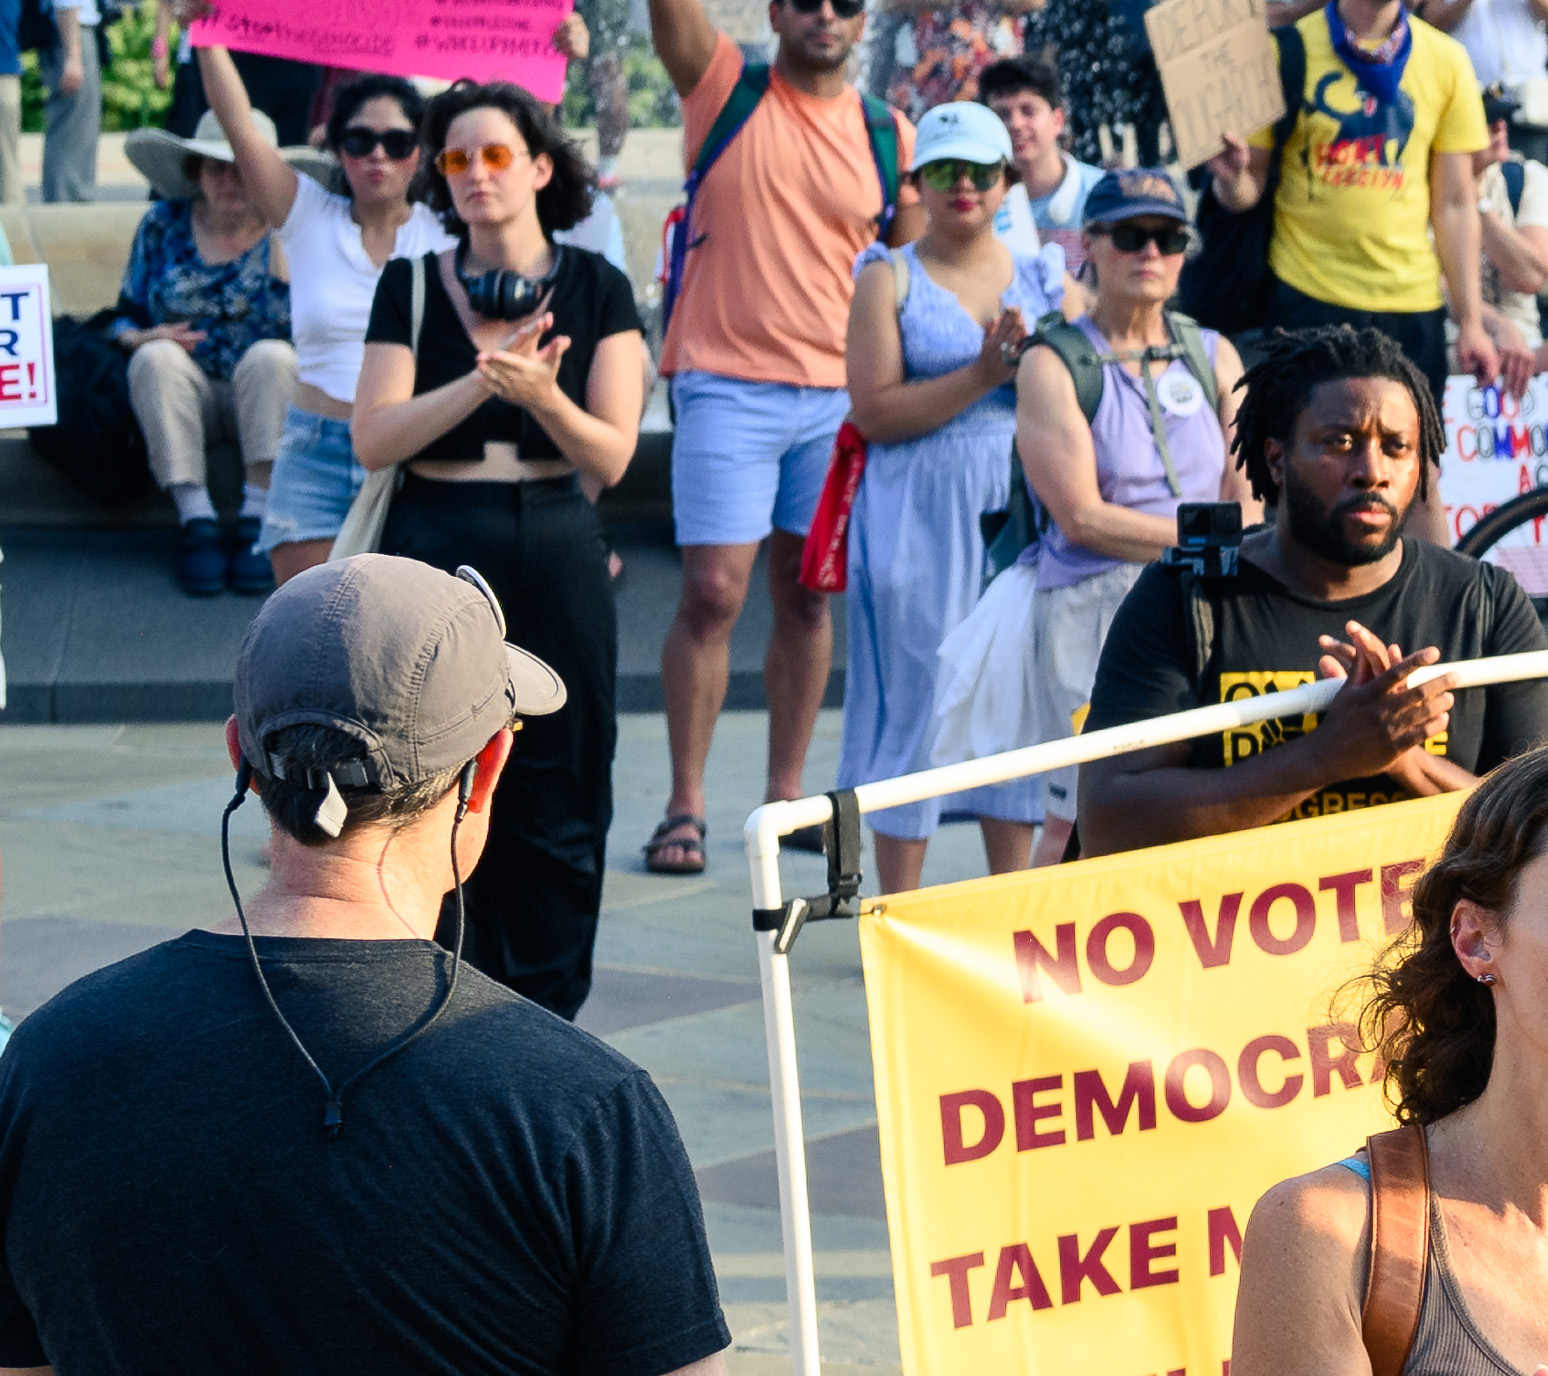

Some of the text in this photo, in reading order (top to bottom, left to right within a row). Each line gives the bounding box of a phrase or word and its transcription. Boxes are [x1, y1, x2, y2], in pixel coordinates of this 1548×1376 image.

[1012, 910, 1156, 1005] NO
[937, 1023, 1392, 1167] DEMOCR
[929, 1214, 1180, 1331] TAKE
